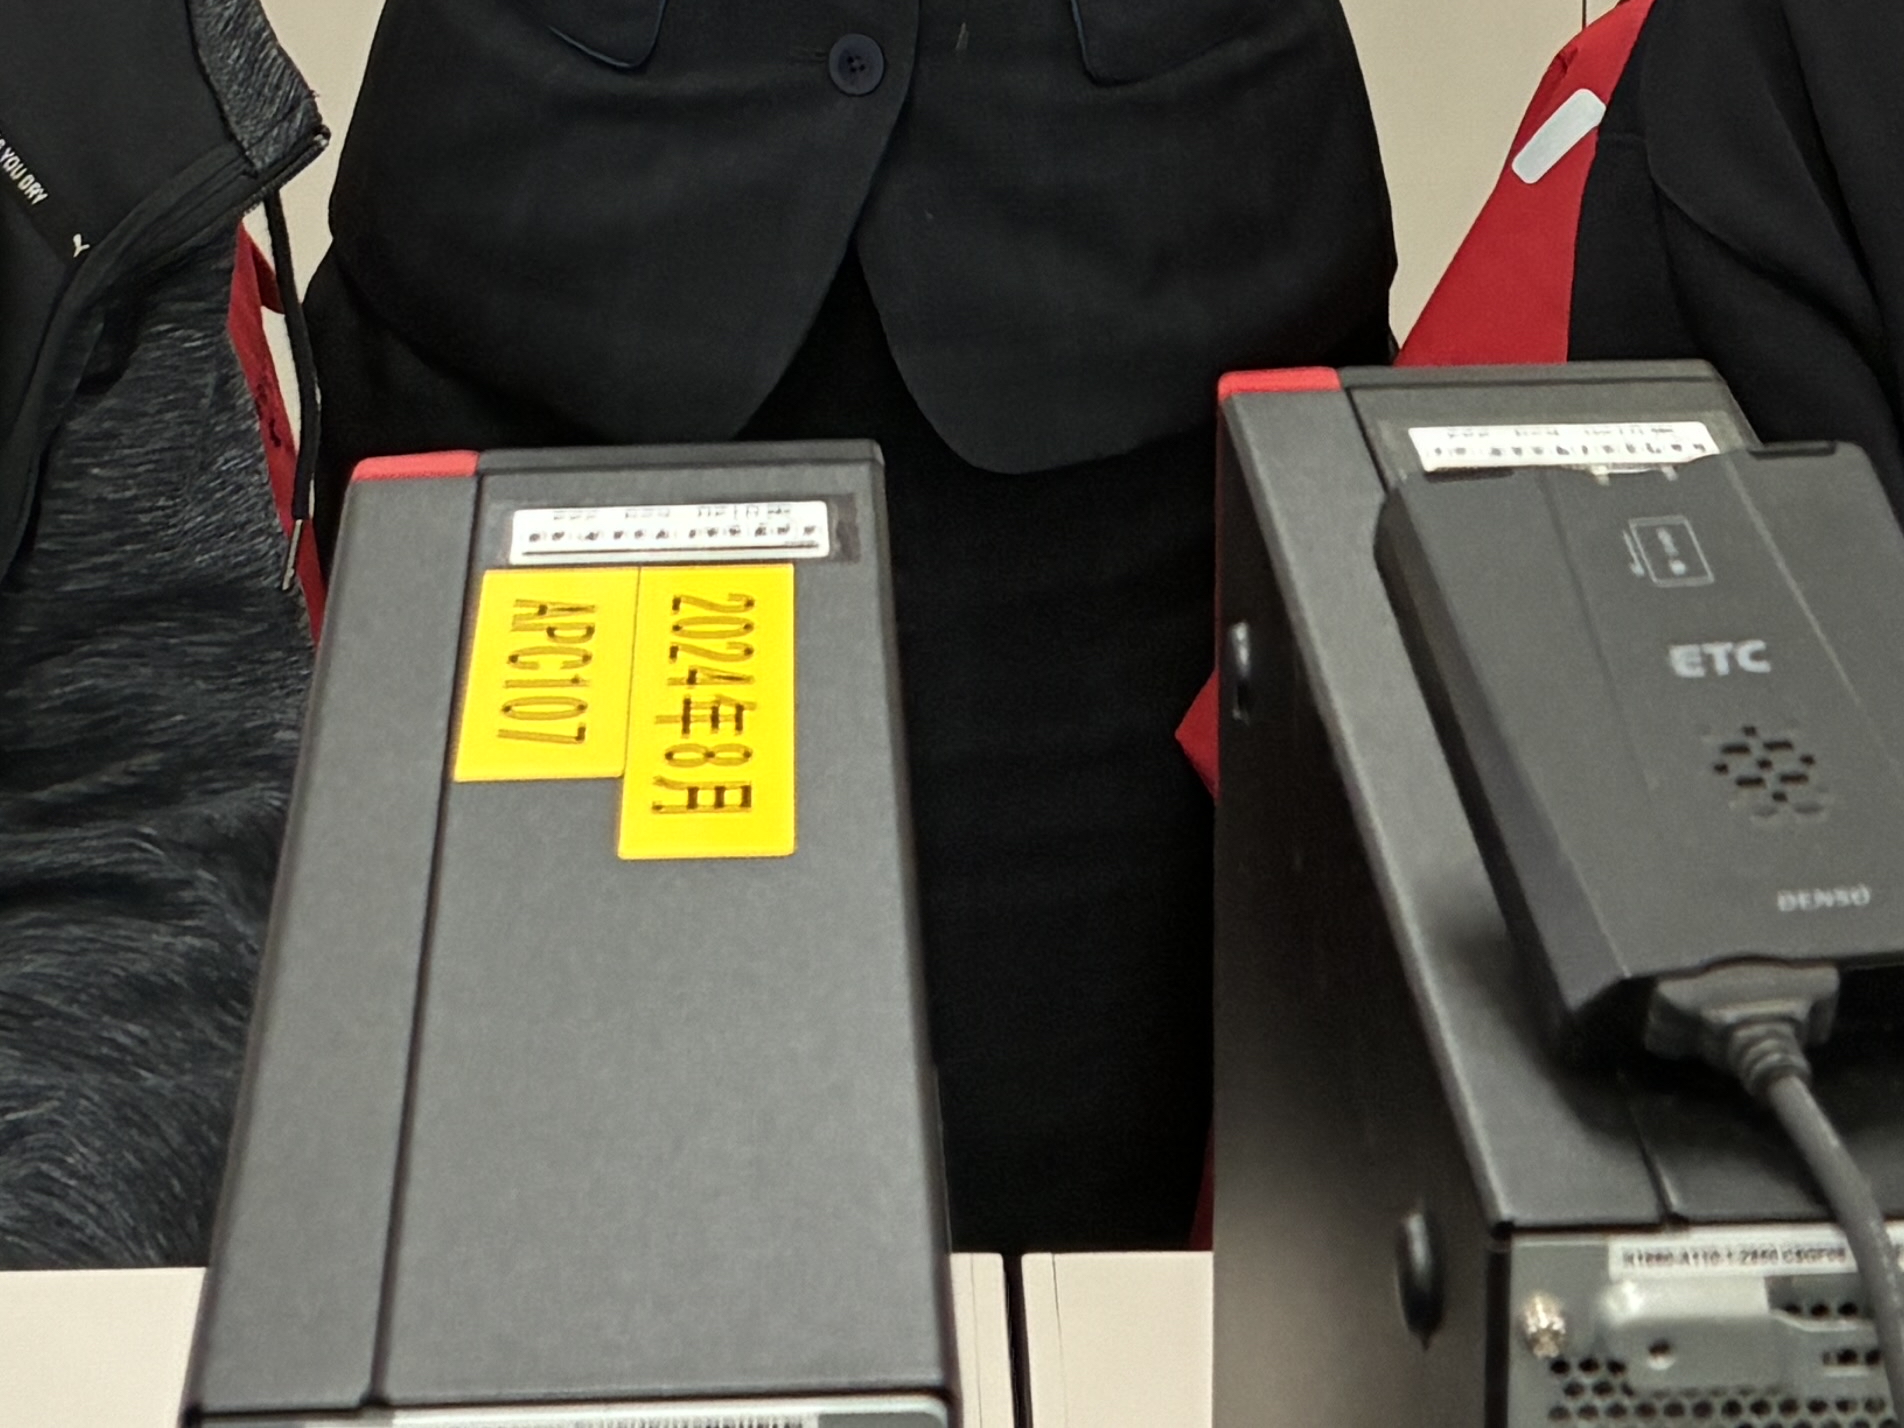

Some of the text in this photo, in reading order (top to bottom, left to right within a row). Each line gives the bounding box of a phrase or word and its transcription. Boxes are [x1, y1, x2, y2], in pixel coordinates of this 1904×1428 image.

[496, 597, 597, 744] APC107
[650, 592, 757, 815] 2024年8月
[1668, 639, 1773, 679] ETC
[1776, 885, 1873, 911] DENSO
